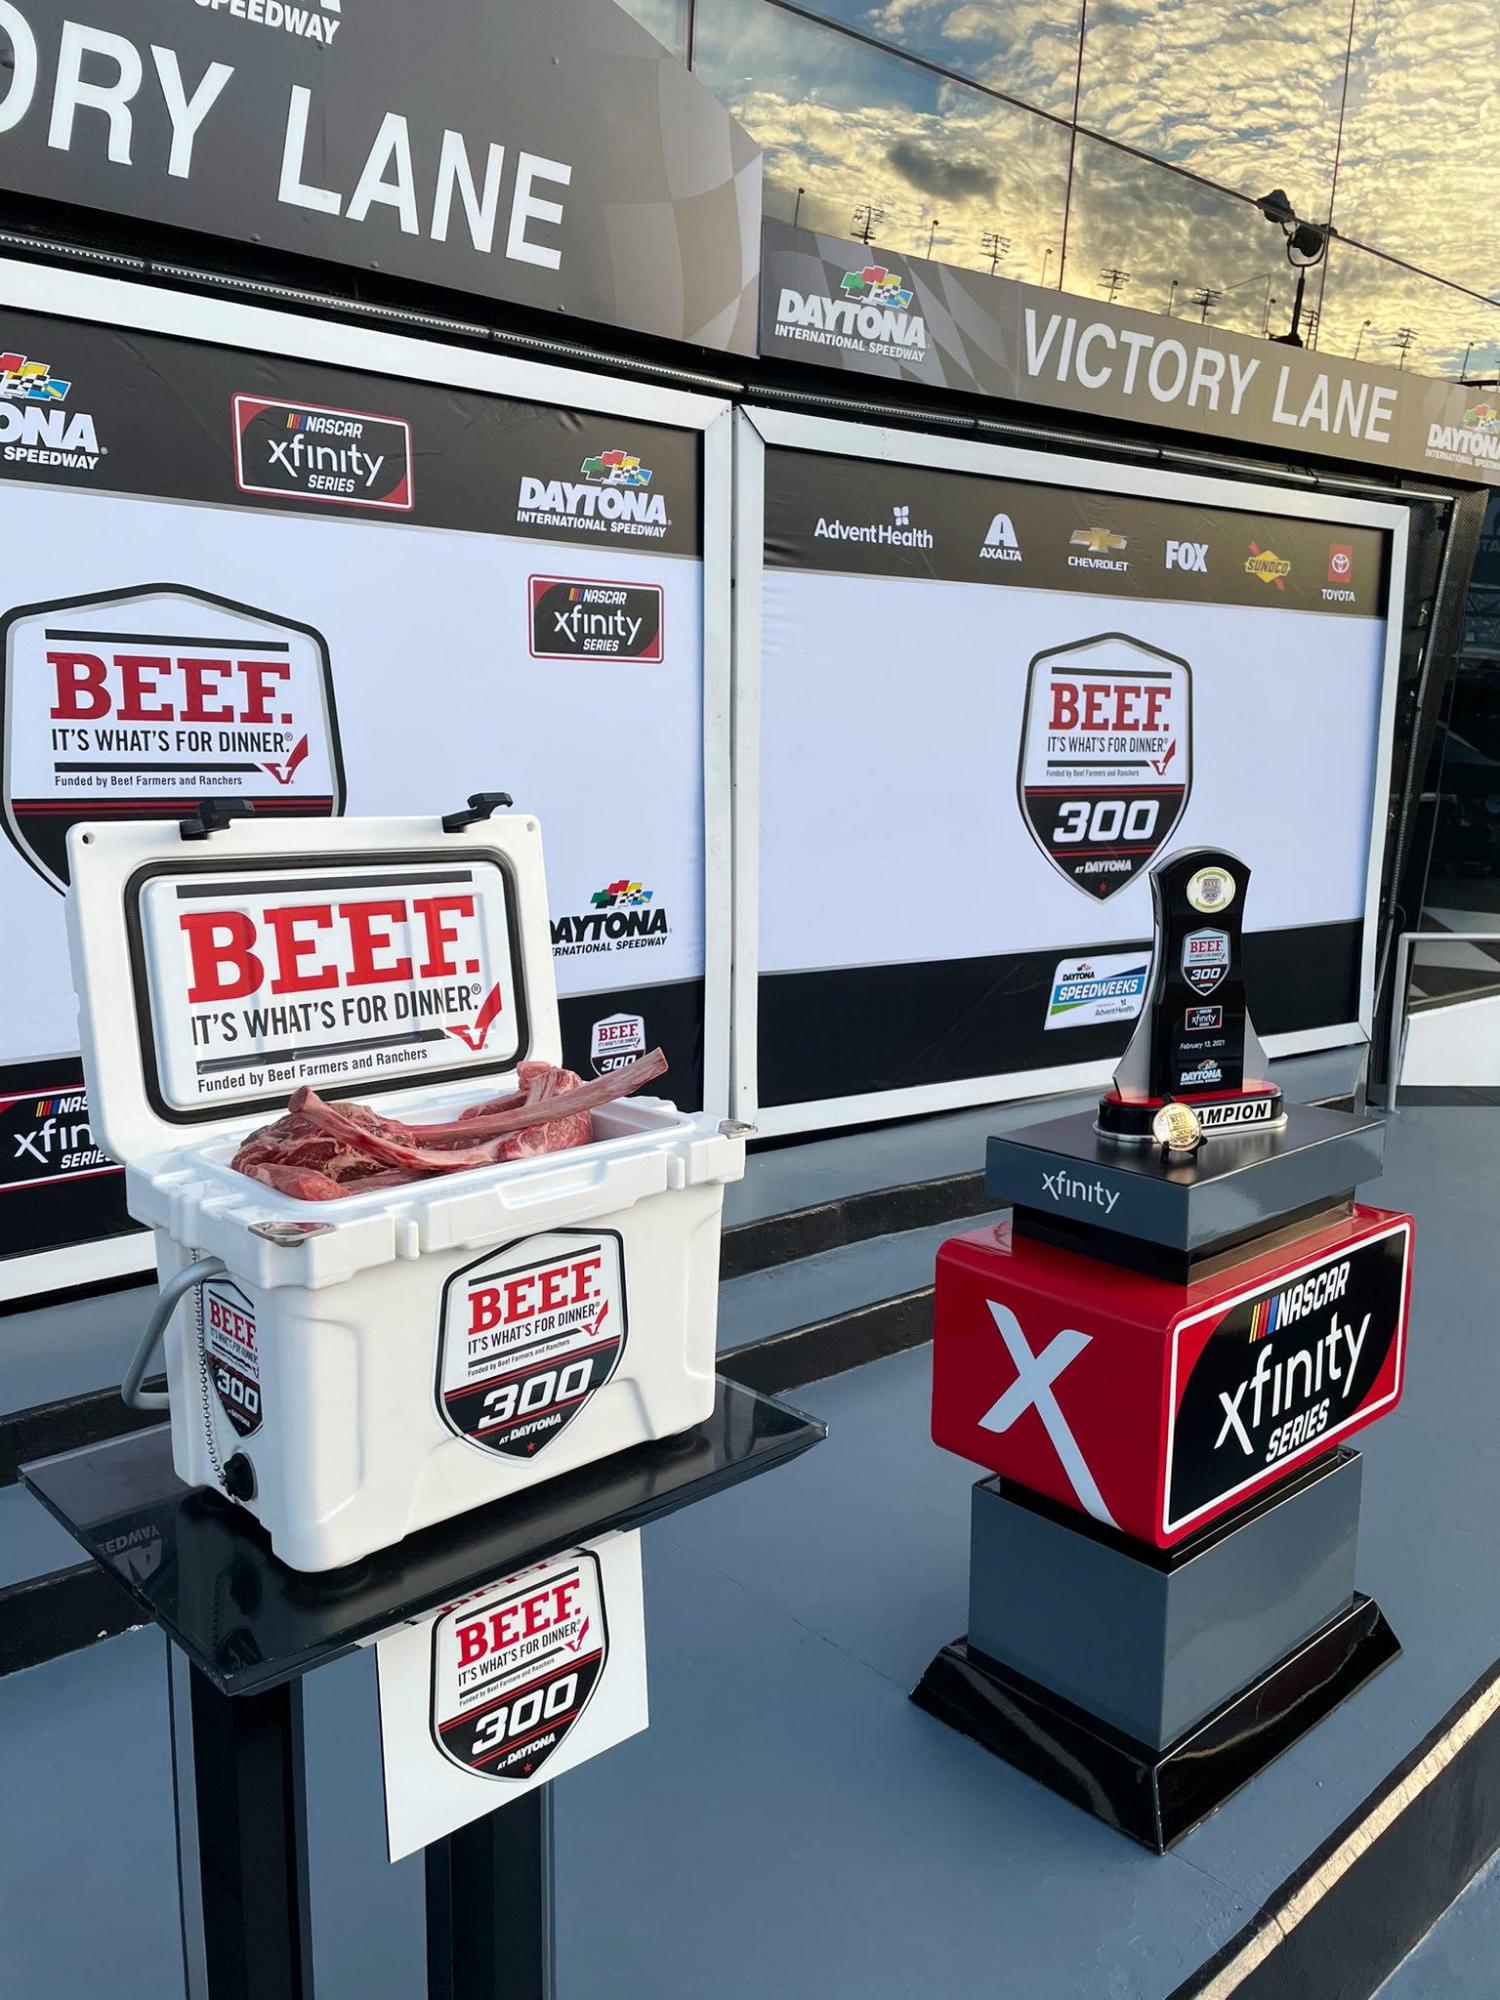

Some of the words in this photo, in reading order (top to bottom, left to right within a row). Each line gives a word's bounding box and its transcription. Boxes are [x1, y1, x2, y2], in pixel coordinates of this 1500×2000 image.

[194, 0, 340, 44] EEDWAY
[278, 84, 573, 271] LANE
[777, 288, 926, 349] DAYTONA
[775, 324, 865, 351] INTERNATIONAL
[868, 342, 925, 362] SPEEDWAY
[1025, 308, 1261, 415] VICTORY
[1271, 365, 1398, 444] LANE
[306, 416, 363, 439] NASCAR
[4, 446, 99, 470] SPEEDWAY
[268, 434, 384, 487] xfinity
[308, 474, 355, 492] SERIES
[518, 476, 667, 525] DAYTONA
[516, 510, 607, 532] INTERNATIONAL
[610, 522, 666, 538] SPEEDWAY
[814, 517, 934, 549] AdventHealth
[979, 547, 1022, 561] AXALTA
[1068, 554, 1129, 572] CHEVROLET
[1165, 540, 1209, 572] FOX
[1247, 559, 1290, 575] SUNOCO
[583, 588, 627, 605] NASCAR
[1321, 588, 1355, 602] TOYOTA
[554, 605, 642, 645] xfinity
[583, 638, 619, 651] SERIES
[46, 652, 293, 724] BEEF.
[1048, 683, 1171, 731] BEEF.
[51, 729, 89, 751] IT'S
[94, 730, 169, 751] WHAT'S
[175, 731, 213, 752] FOR
[1047, 736, 1066, 752] IT'S
[1069, 737, 1105, 753] WHAT'S
[1107, 737, 1126, 753] FOR
[55, 776, 92, 786] Funded
[96, 776, 108, 788] by
[111, 776, 133, 786] Beef
[136, 776, 177, 786] Farmers
[179, 776, 196, 786] and
[199, 775, 242, 786] Ranchers
[1052, 800, 1160, 842] 300
[1084, 859, 1132, 873] DAYTONA
[179, 895, 481, 1004] BEEF.
[616, 936, 667, 950] SPEEDWAY
[1058, 979, 1139, 1001] SPEEDWEEKS
[1062, 972, 1095, 981] DAYTONA
[1190, 967, 1221, 980] 300
[192, 1012, 237, 1046] IT'S
[243, 1001, 336, 1038] WHAT'S
[343, 995, 388, 1026] FOR
[1095, 1005, 1134, 1016] AdventHealth
[1191, 1012, 1217, 1026] xfinity
[601, 1055, 636, 1071] 300
[1180, 1041, 1203, 1050] February
[198, 1076, 246, 1093] Funded
[250, 1072, 264, 1087] by
[268, 1067, 296, 1082] Beef
[299, 1060, 348, 1078] Farmers
[352, 1056, 373, 1070] and
[376, 1047, 427, 1066] Ranchers
[1180, 1069, 1222, 1082] DAYTONA
[1040, 1170, 1121, 1214] xfinity
[468, 1257, 601, 1336] BEEF.
[1273, 1260, 1351, 1331] NASCAR
[468, 1336, 488, 1355] IT'S
[491, 1323, 531, 1347] WHAT'S
[535, 1316, 555, 1334] FOR
[468, 1366, 489, 1377] Funded
[490, 1363, 496, 1372] by
[497, 1358, 510, 1367] Beef
[511, 1351, 534, 1364] Farmers
[535, 1347, 544, 1356] and
[546, 1339, 570, 1352] Ranchers
[217, 1368, 259, 1414] 300
[478, 1358, 594, 1429] 300
[1213, 1311, 1372, 1456] xfinity
[499, 1436, 509, 1445] AT
[510, 1413, 561, 1441] DAYTONA
[1265, 1398, 1330, 1464] SERIES
[456, 1578, 581, 1669] BEEF.
[458, 1667, 477, 1687] IT'S
[479, 1648, 518, 1676] WHAT'S
[520, 1639, 539, 1657] FOR
[459, 1694, 479, 1707] Funded
[472, 1673, 578, 1754] 300
[497, 1761, 507, 1771] AT
[507, 1733, 556, 1765] DAYTONA
